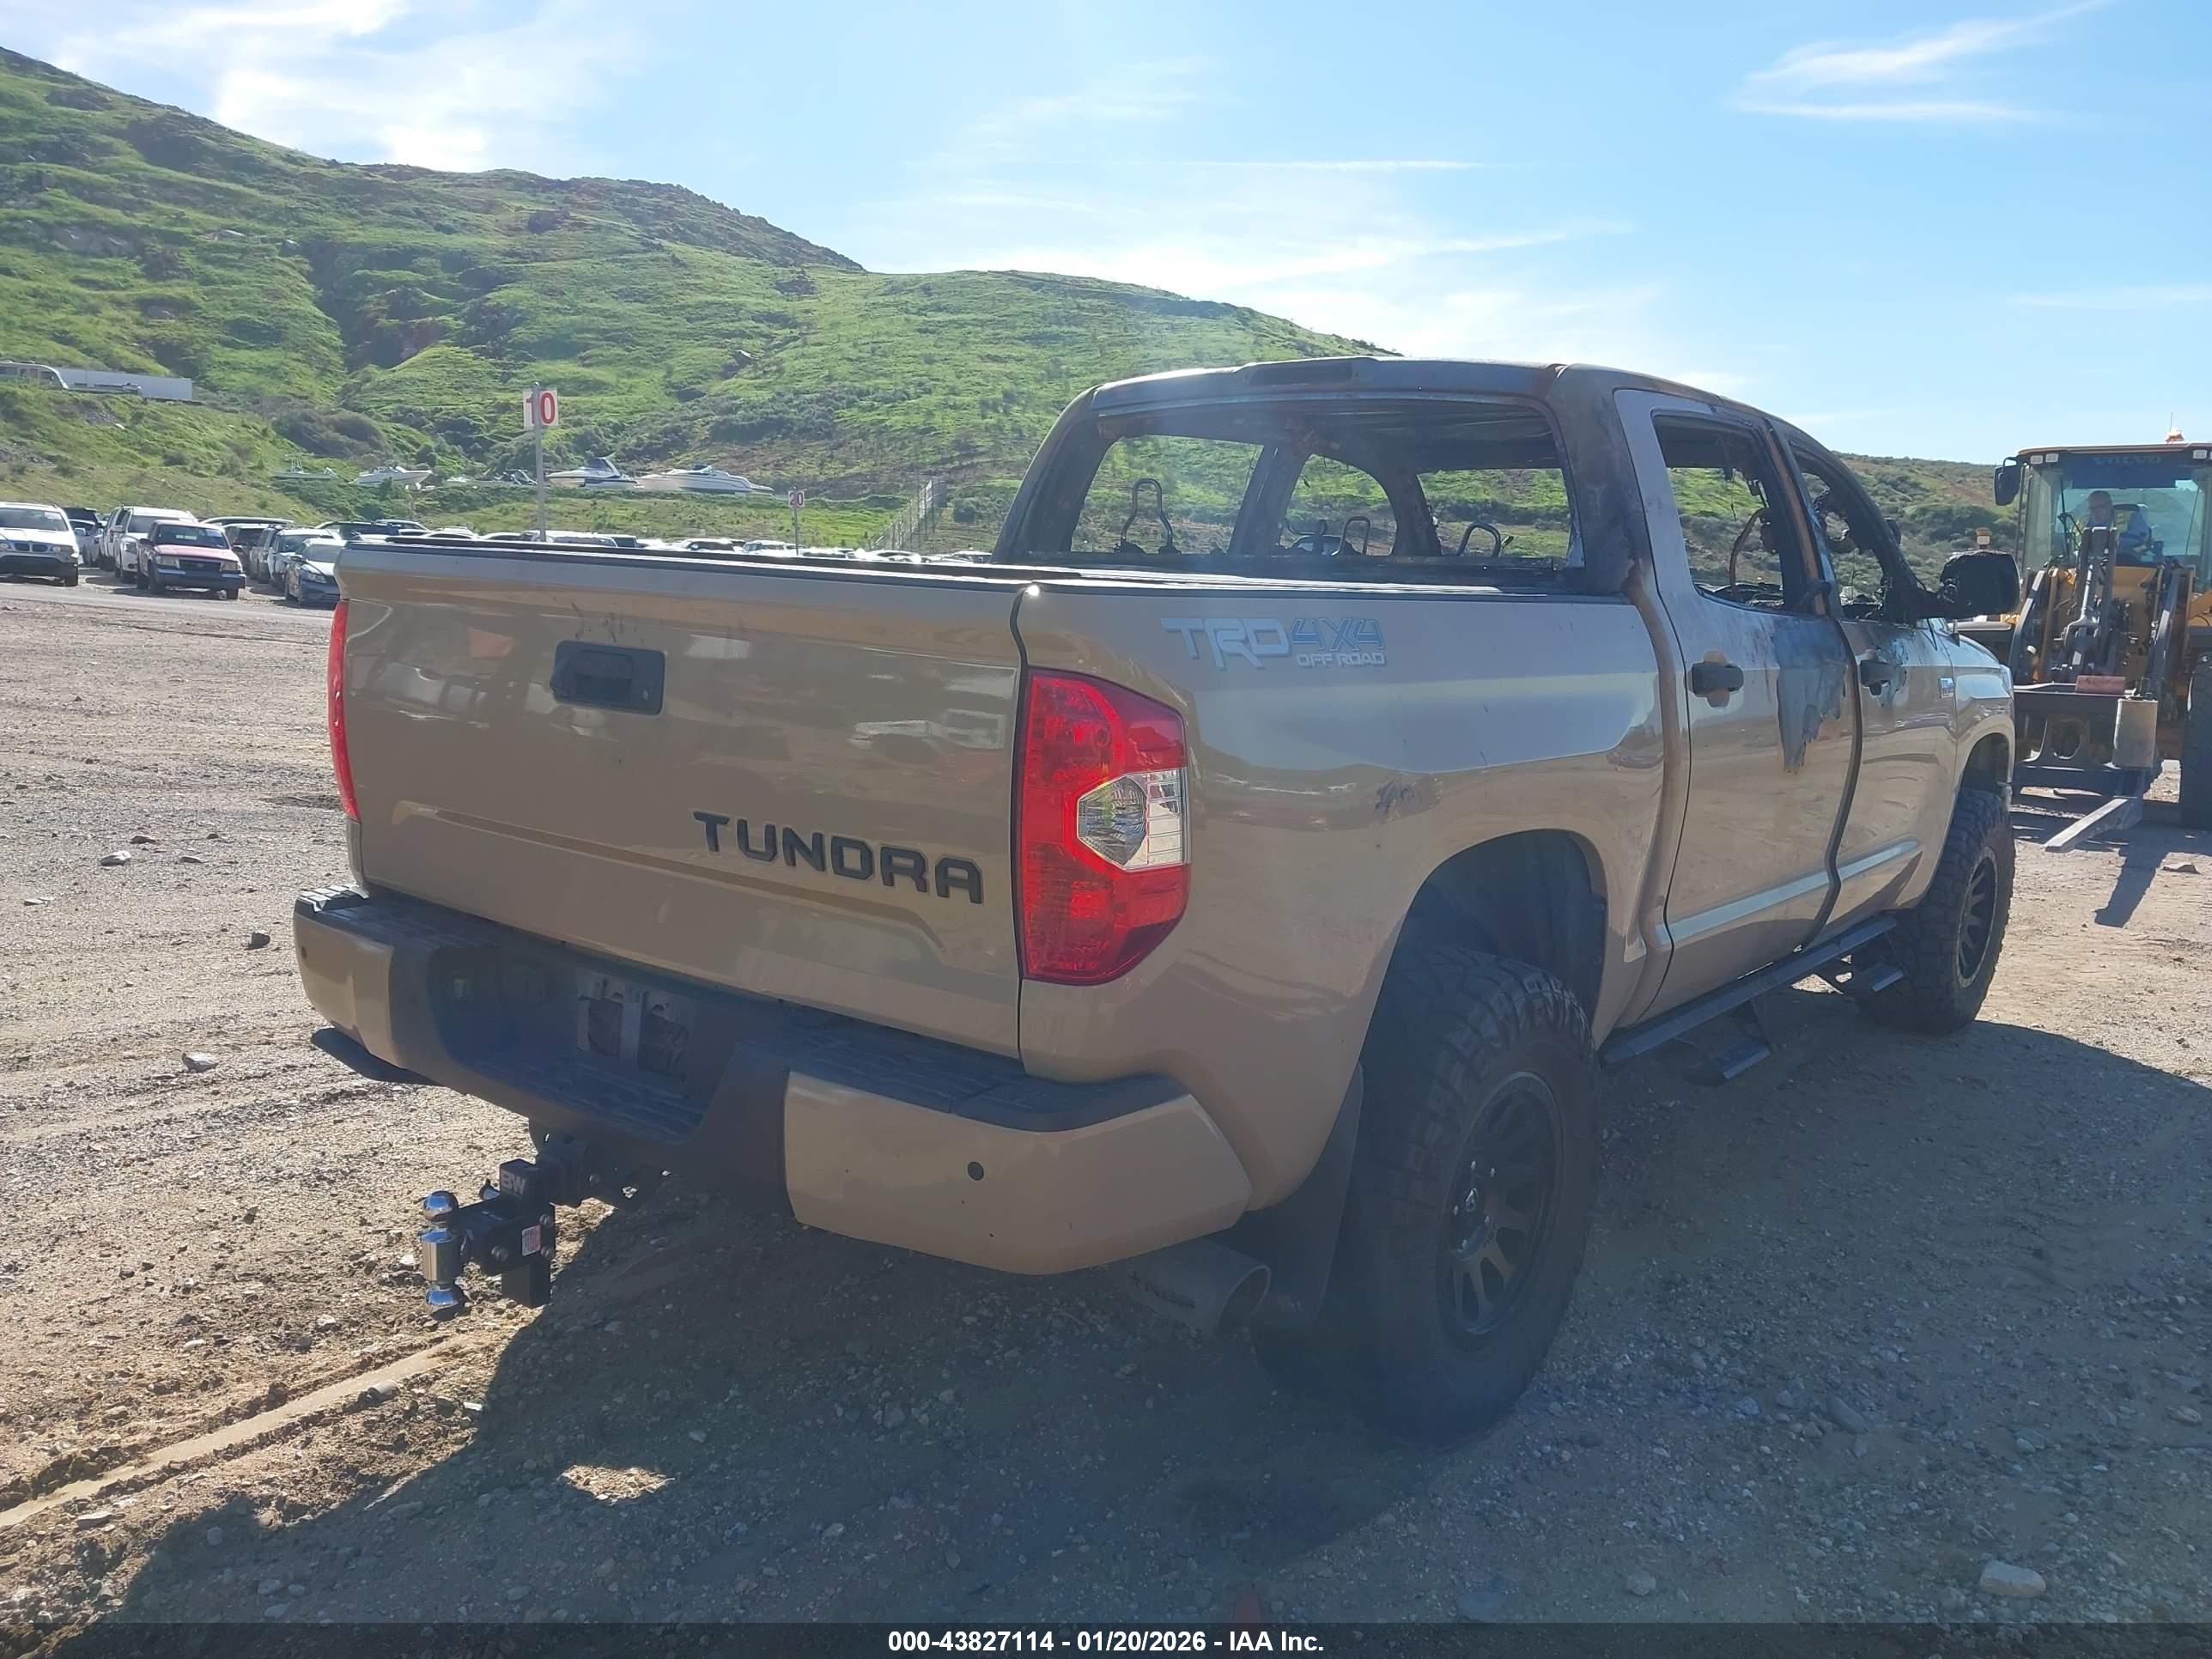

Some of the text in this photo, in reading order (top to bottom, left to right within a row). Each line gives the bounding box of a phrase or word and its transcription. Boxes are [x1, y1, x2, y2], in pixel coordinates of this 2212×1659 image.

[1160, 617, 1291, 671] TRD
[1297, 652, 1386, 667] OFF ROAD
[693, 810, 984, 905] TUNDRA
